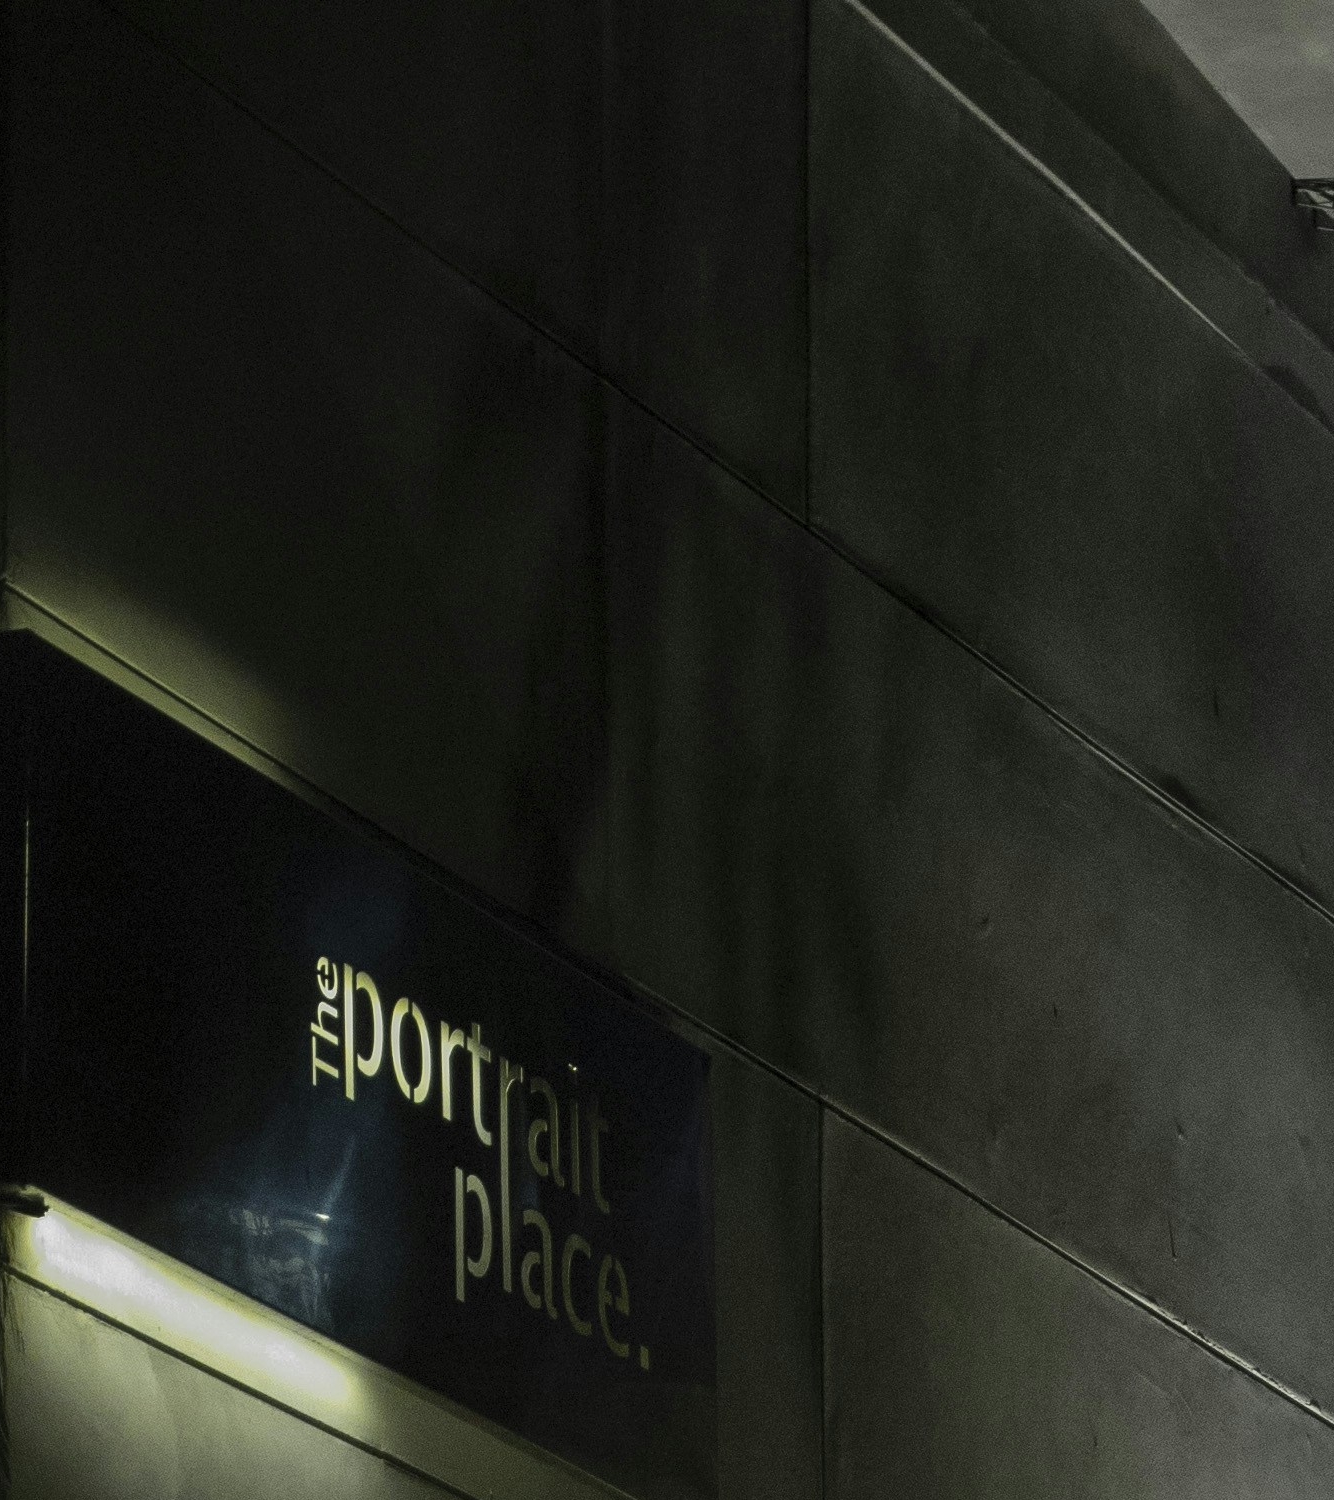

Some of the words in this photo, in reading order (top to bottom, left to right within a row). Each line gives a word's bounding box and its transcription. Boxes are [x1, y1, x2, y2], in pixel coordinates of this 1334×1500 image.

[309, 955, 341, 1087] The
[342, 962, 611, 1214] portrait
[453, 1150, 650, 1372] place.
